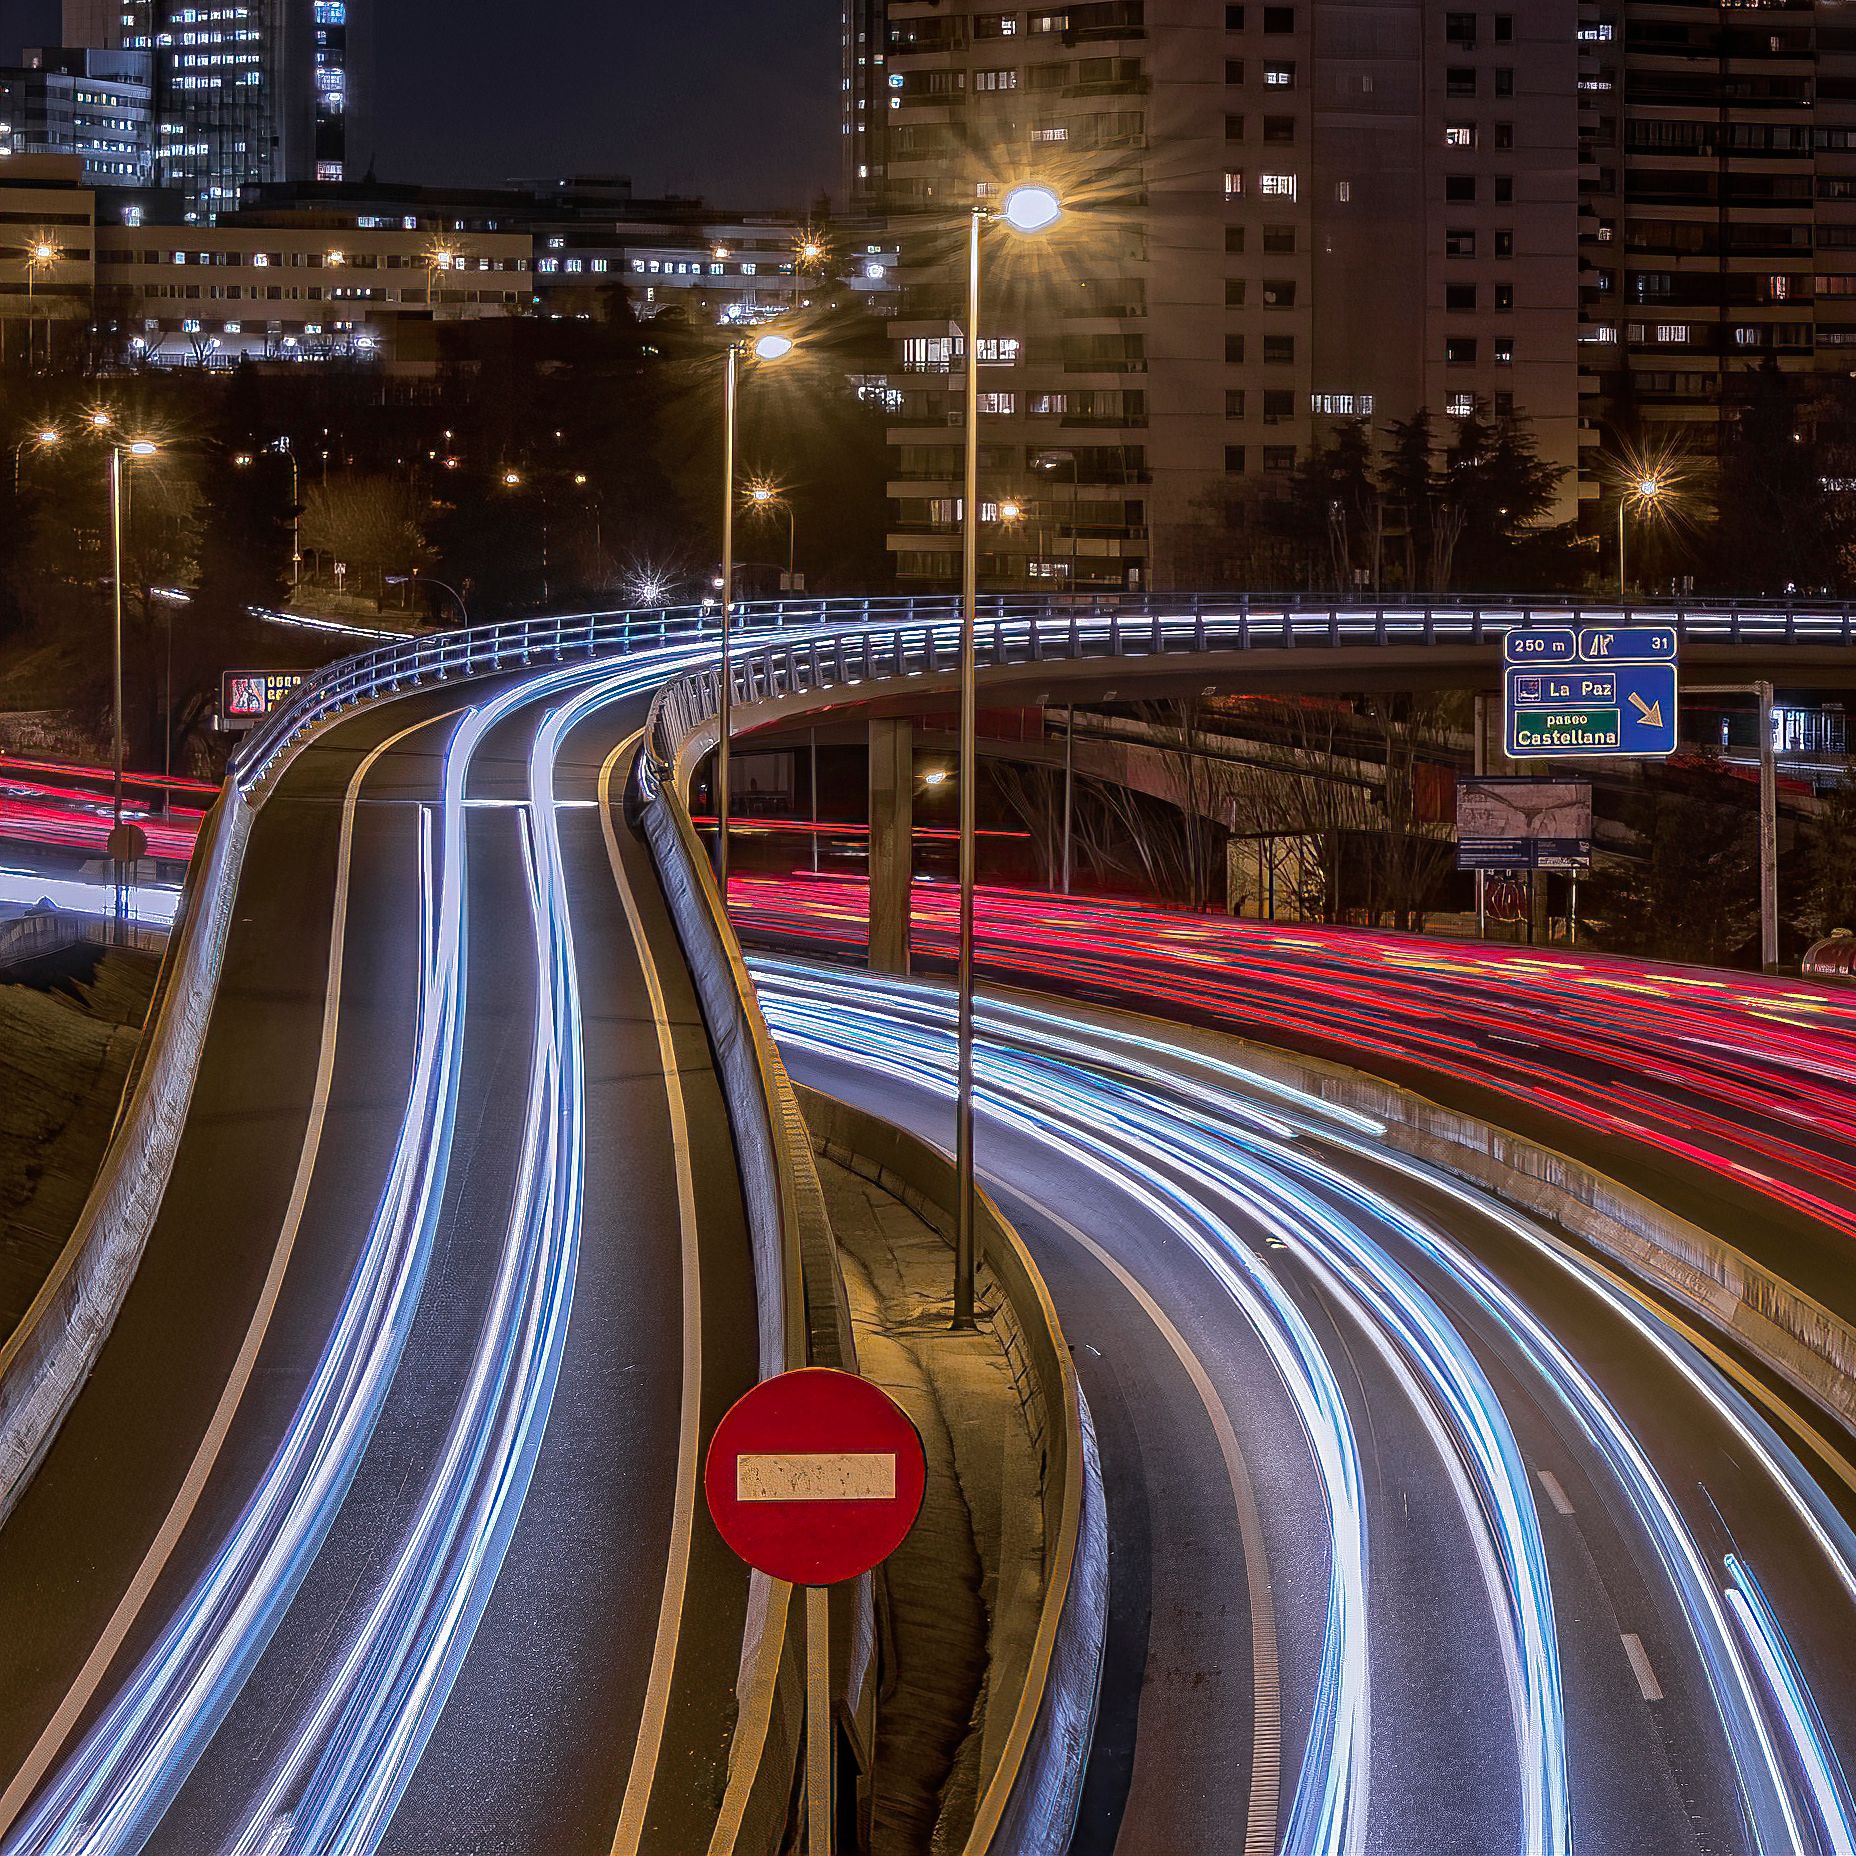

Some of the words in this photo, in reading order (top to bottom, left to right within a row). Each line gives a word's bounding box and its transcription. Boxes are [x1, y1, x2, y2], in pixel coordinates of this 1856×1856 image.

[1515, 639, 1545, 652] 250
[1552, 642, 1565, 652] m
[1651, 637, 1668, 650] 31
[1550, 682, 1570, 697] La
[1581, 681, 1612, 696] Paz
[1518, 729, 1616, 746] Castellana
